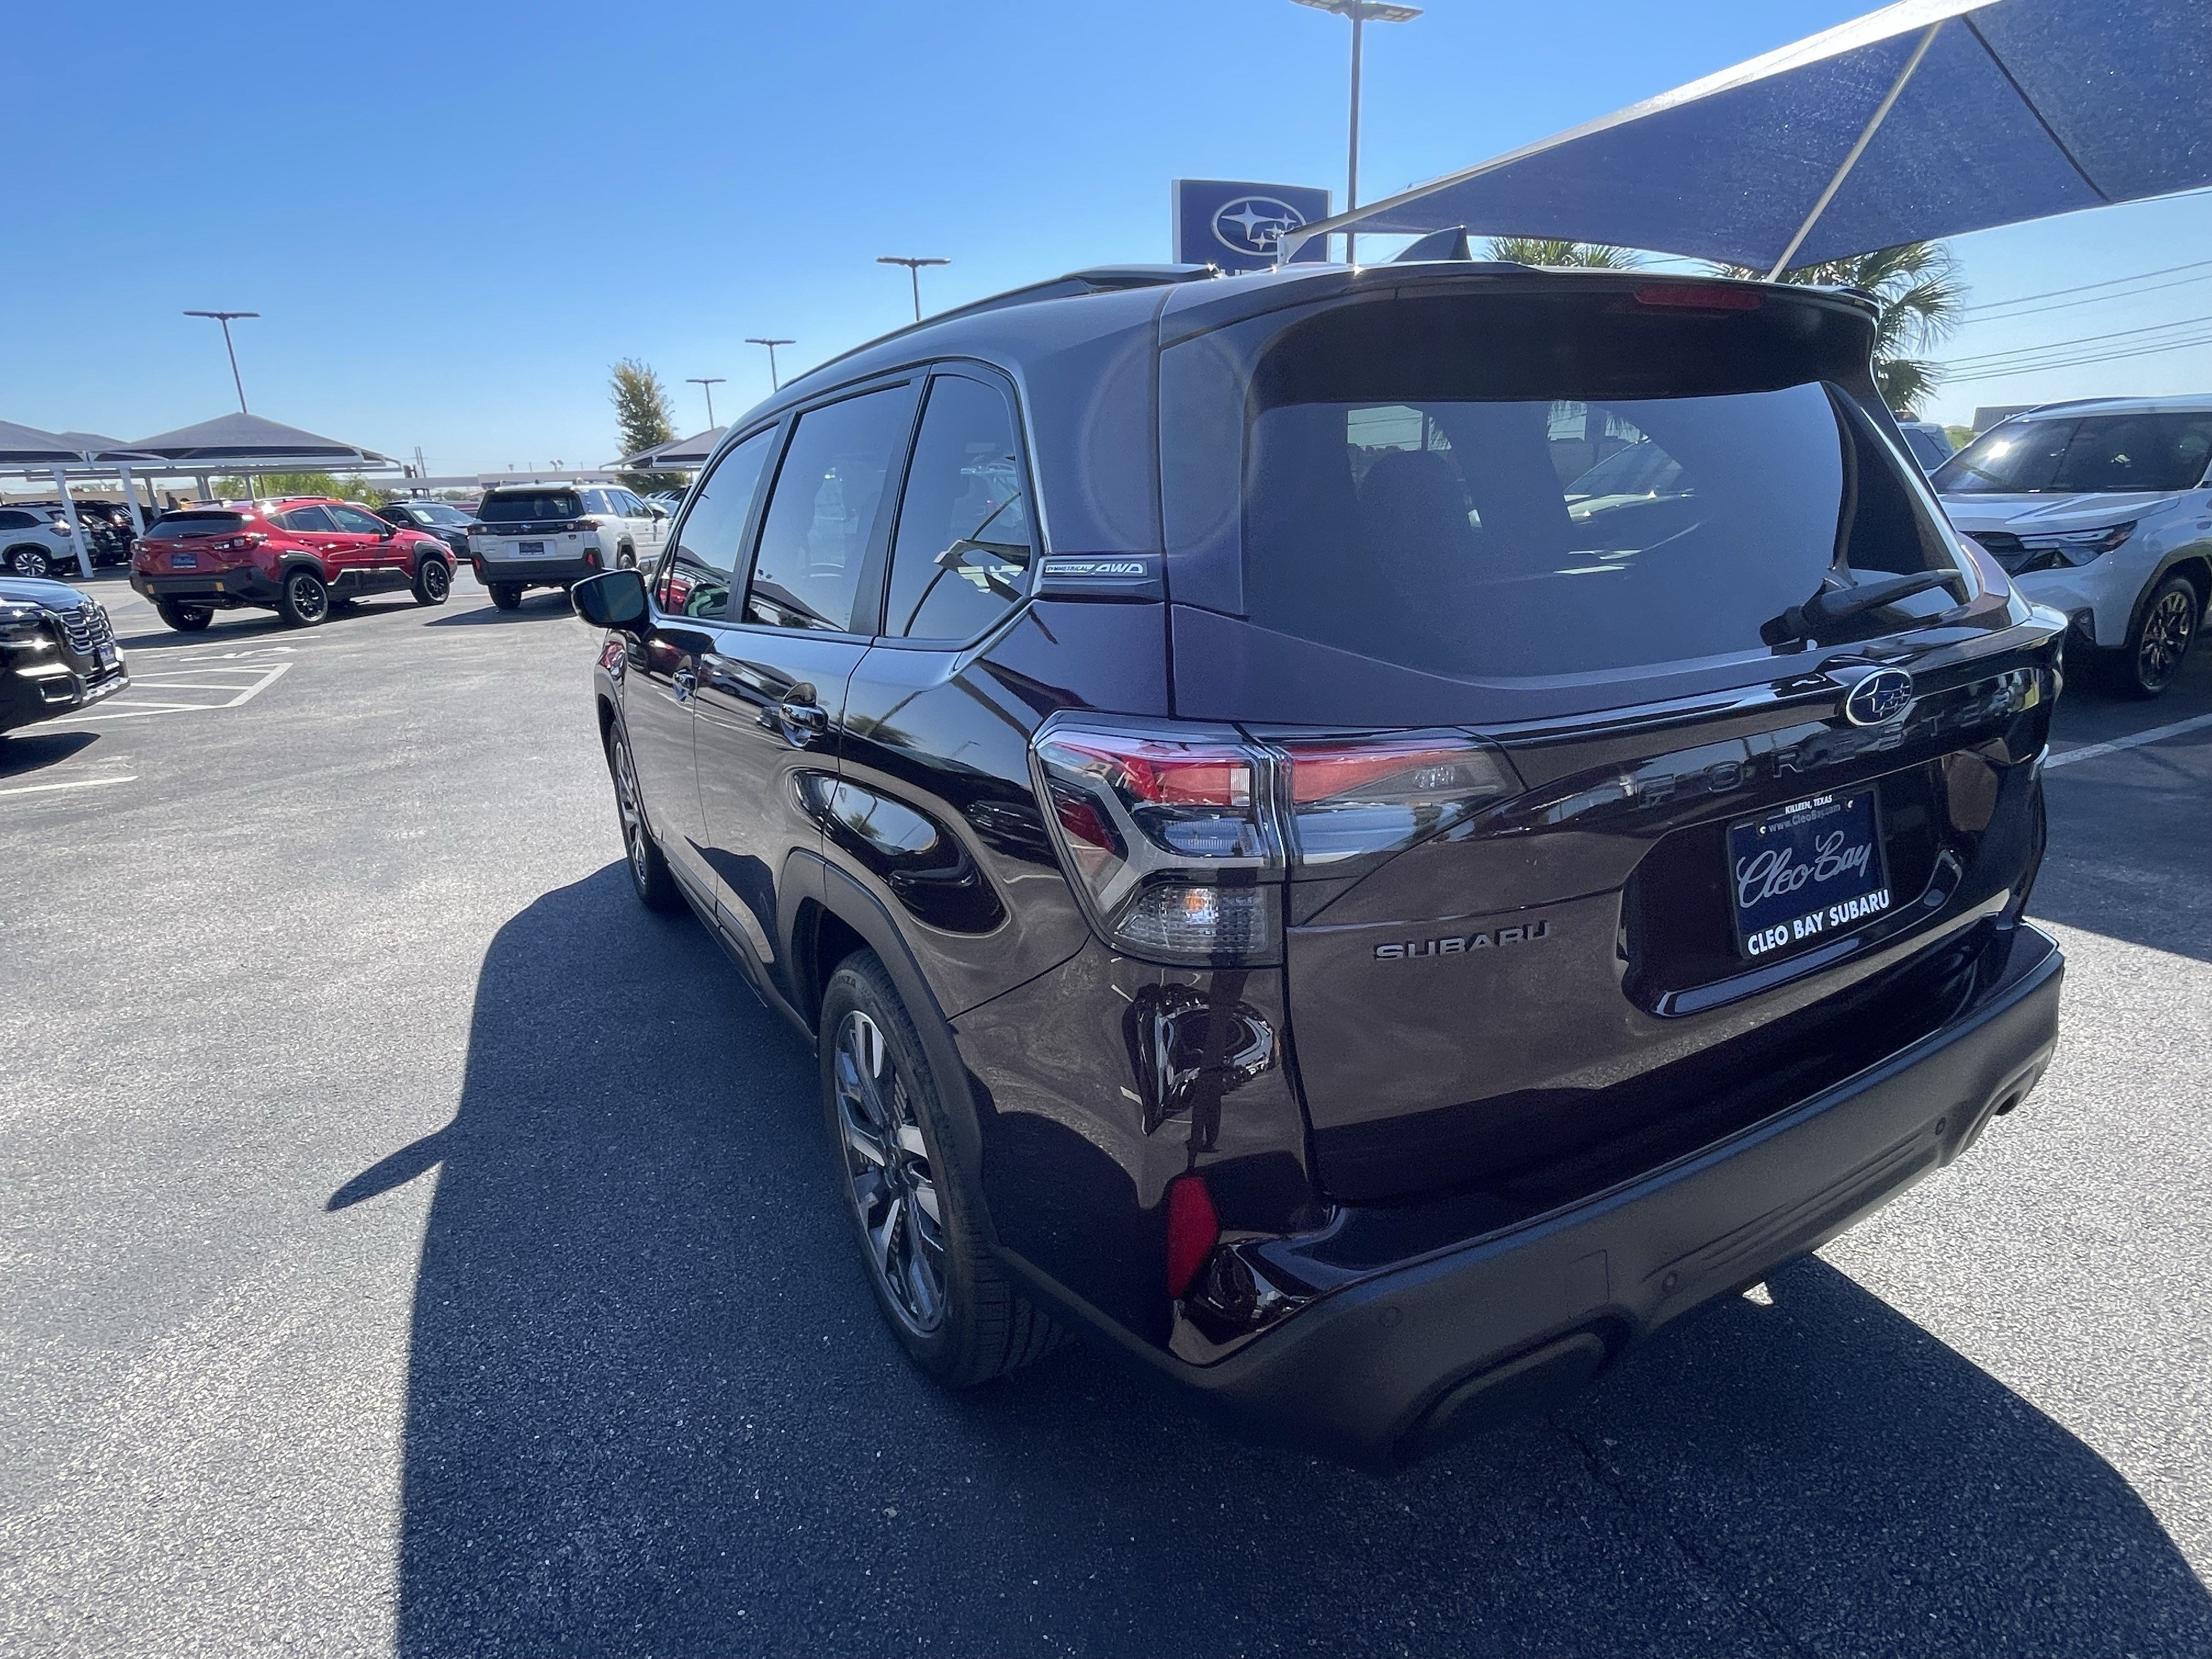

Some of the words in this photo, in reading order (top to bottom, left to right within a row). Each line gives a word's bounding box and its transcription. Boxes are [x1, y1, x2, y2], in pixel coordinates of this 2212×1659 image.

[1095, 563, 1143, 574] AWD
[1813, 794, 1832, 807] TEXAS
[1768, 804, 1842, 833] www.CleoBay.com
[1736, 847, 1814, 909] Cleo
[1814, 830, 1872, 882] Bay
[1748, 925, 1789, 956] CLEO
[1793, 911, 1824, 940] BAY
[1829, 889, 1889, 927] SUBARU
[1375, 920, 1551, 962] SUBARU
